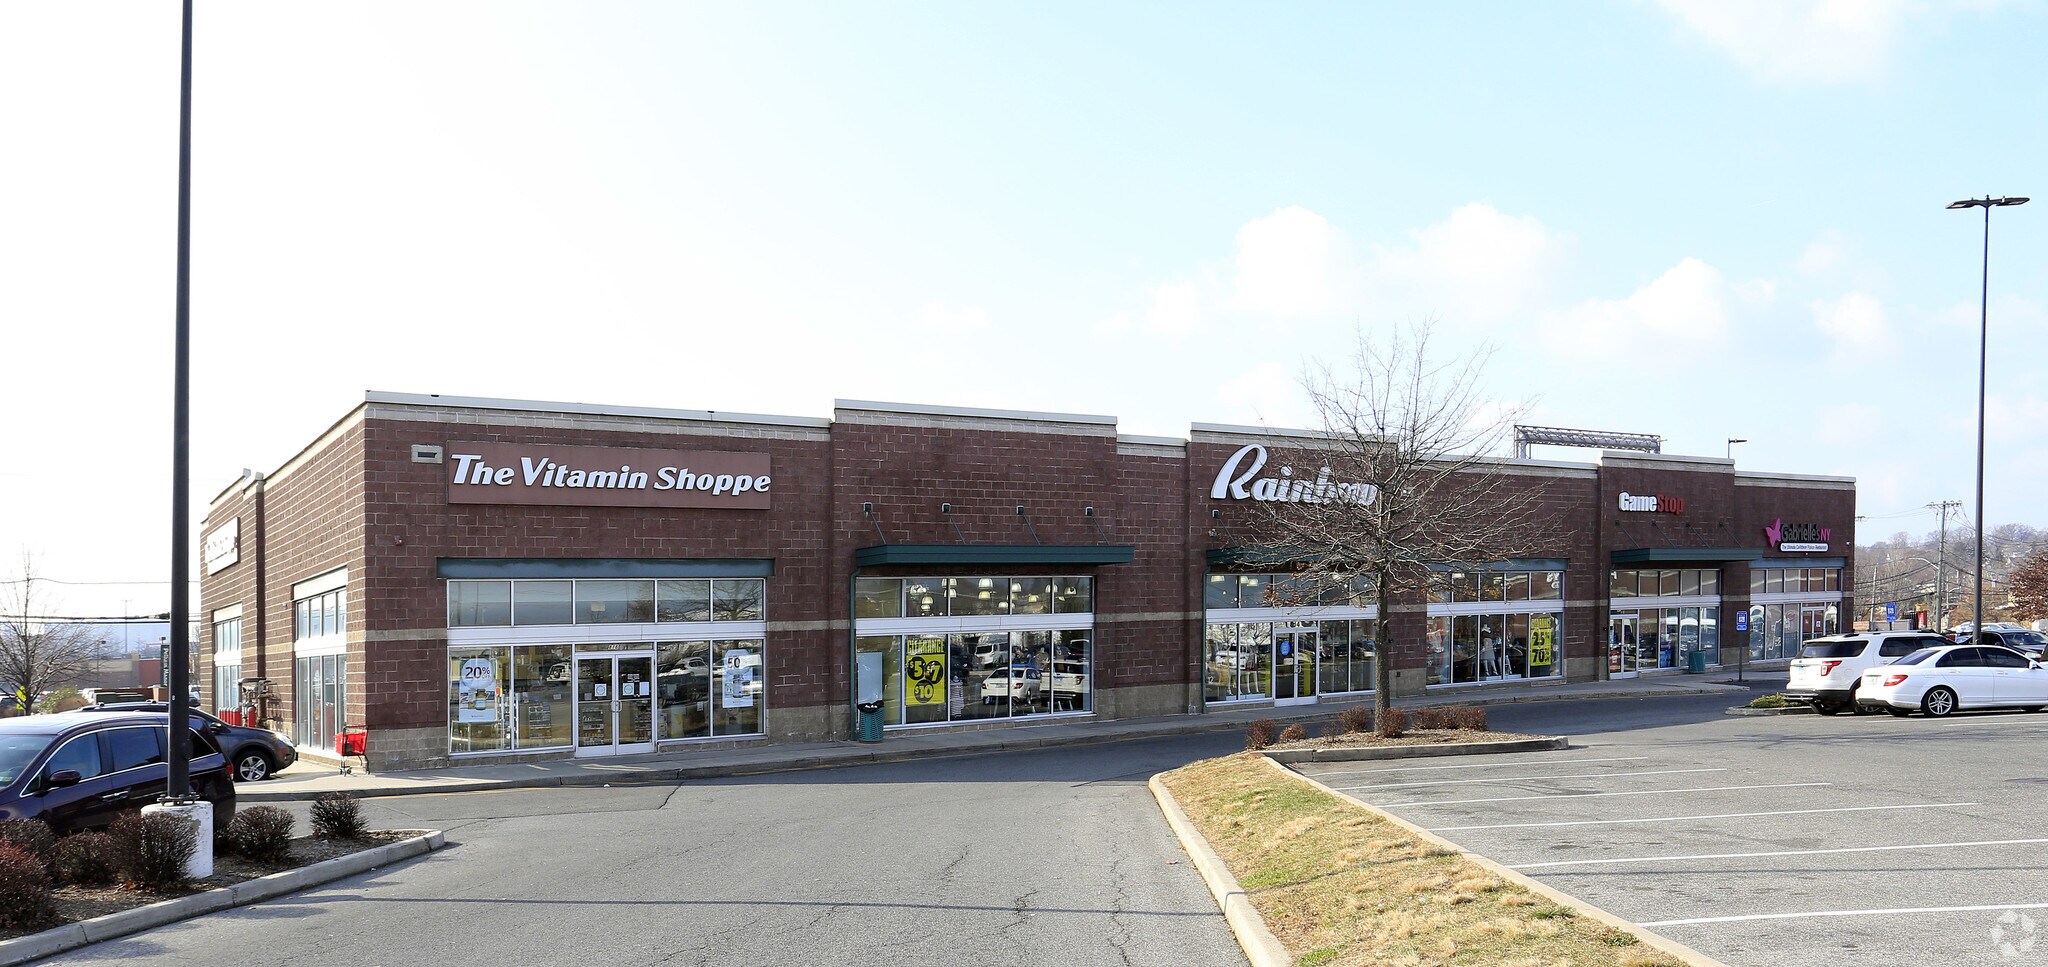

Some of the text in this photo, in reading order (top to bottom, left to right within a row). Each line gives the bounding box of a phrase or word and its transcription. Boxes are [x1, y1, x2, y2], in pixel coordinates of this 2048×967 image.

[451, 454, 771, 496] The Vitamin Shoppe
[1211, 443, 1378, 506] Rainbow
[1618, 491, 1685, 515] GameStop
[1820, 528, 1832, 541] NY
[907, 639, 945, 653] CLEARANCE
[465, 666, 491, 680] 20%
[914, 684, 934, 699] $10
